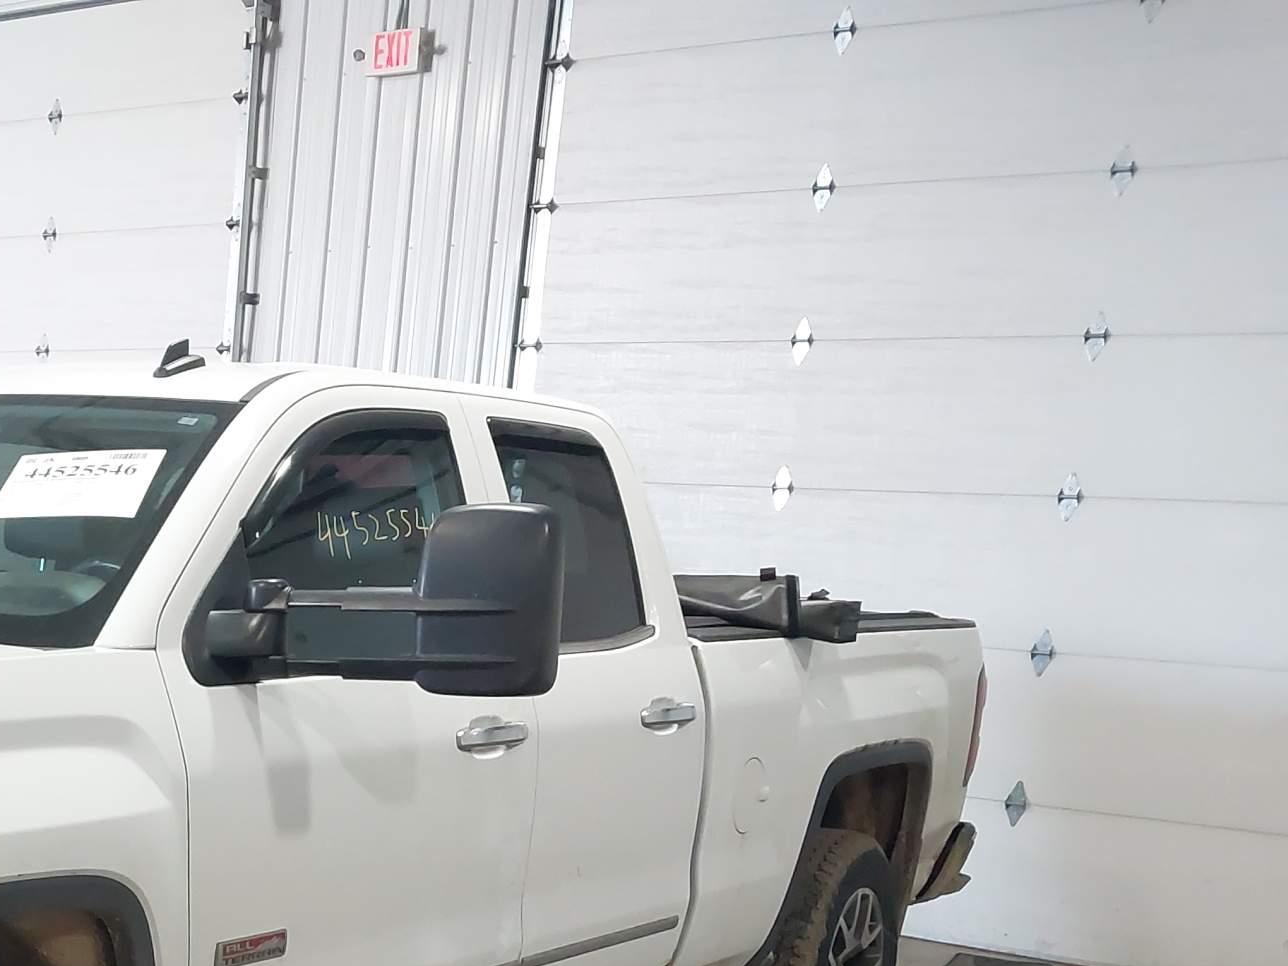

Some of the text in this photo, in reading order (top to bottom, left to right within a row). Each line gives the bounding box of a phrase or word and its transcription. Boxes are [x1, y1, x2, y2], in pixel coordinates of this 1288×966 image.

[373, 30, 413, 70] EXIT
[24, 463, 139, 480] 44525546
[225, 940, 255, 954] ALL
